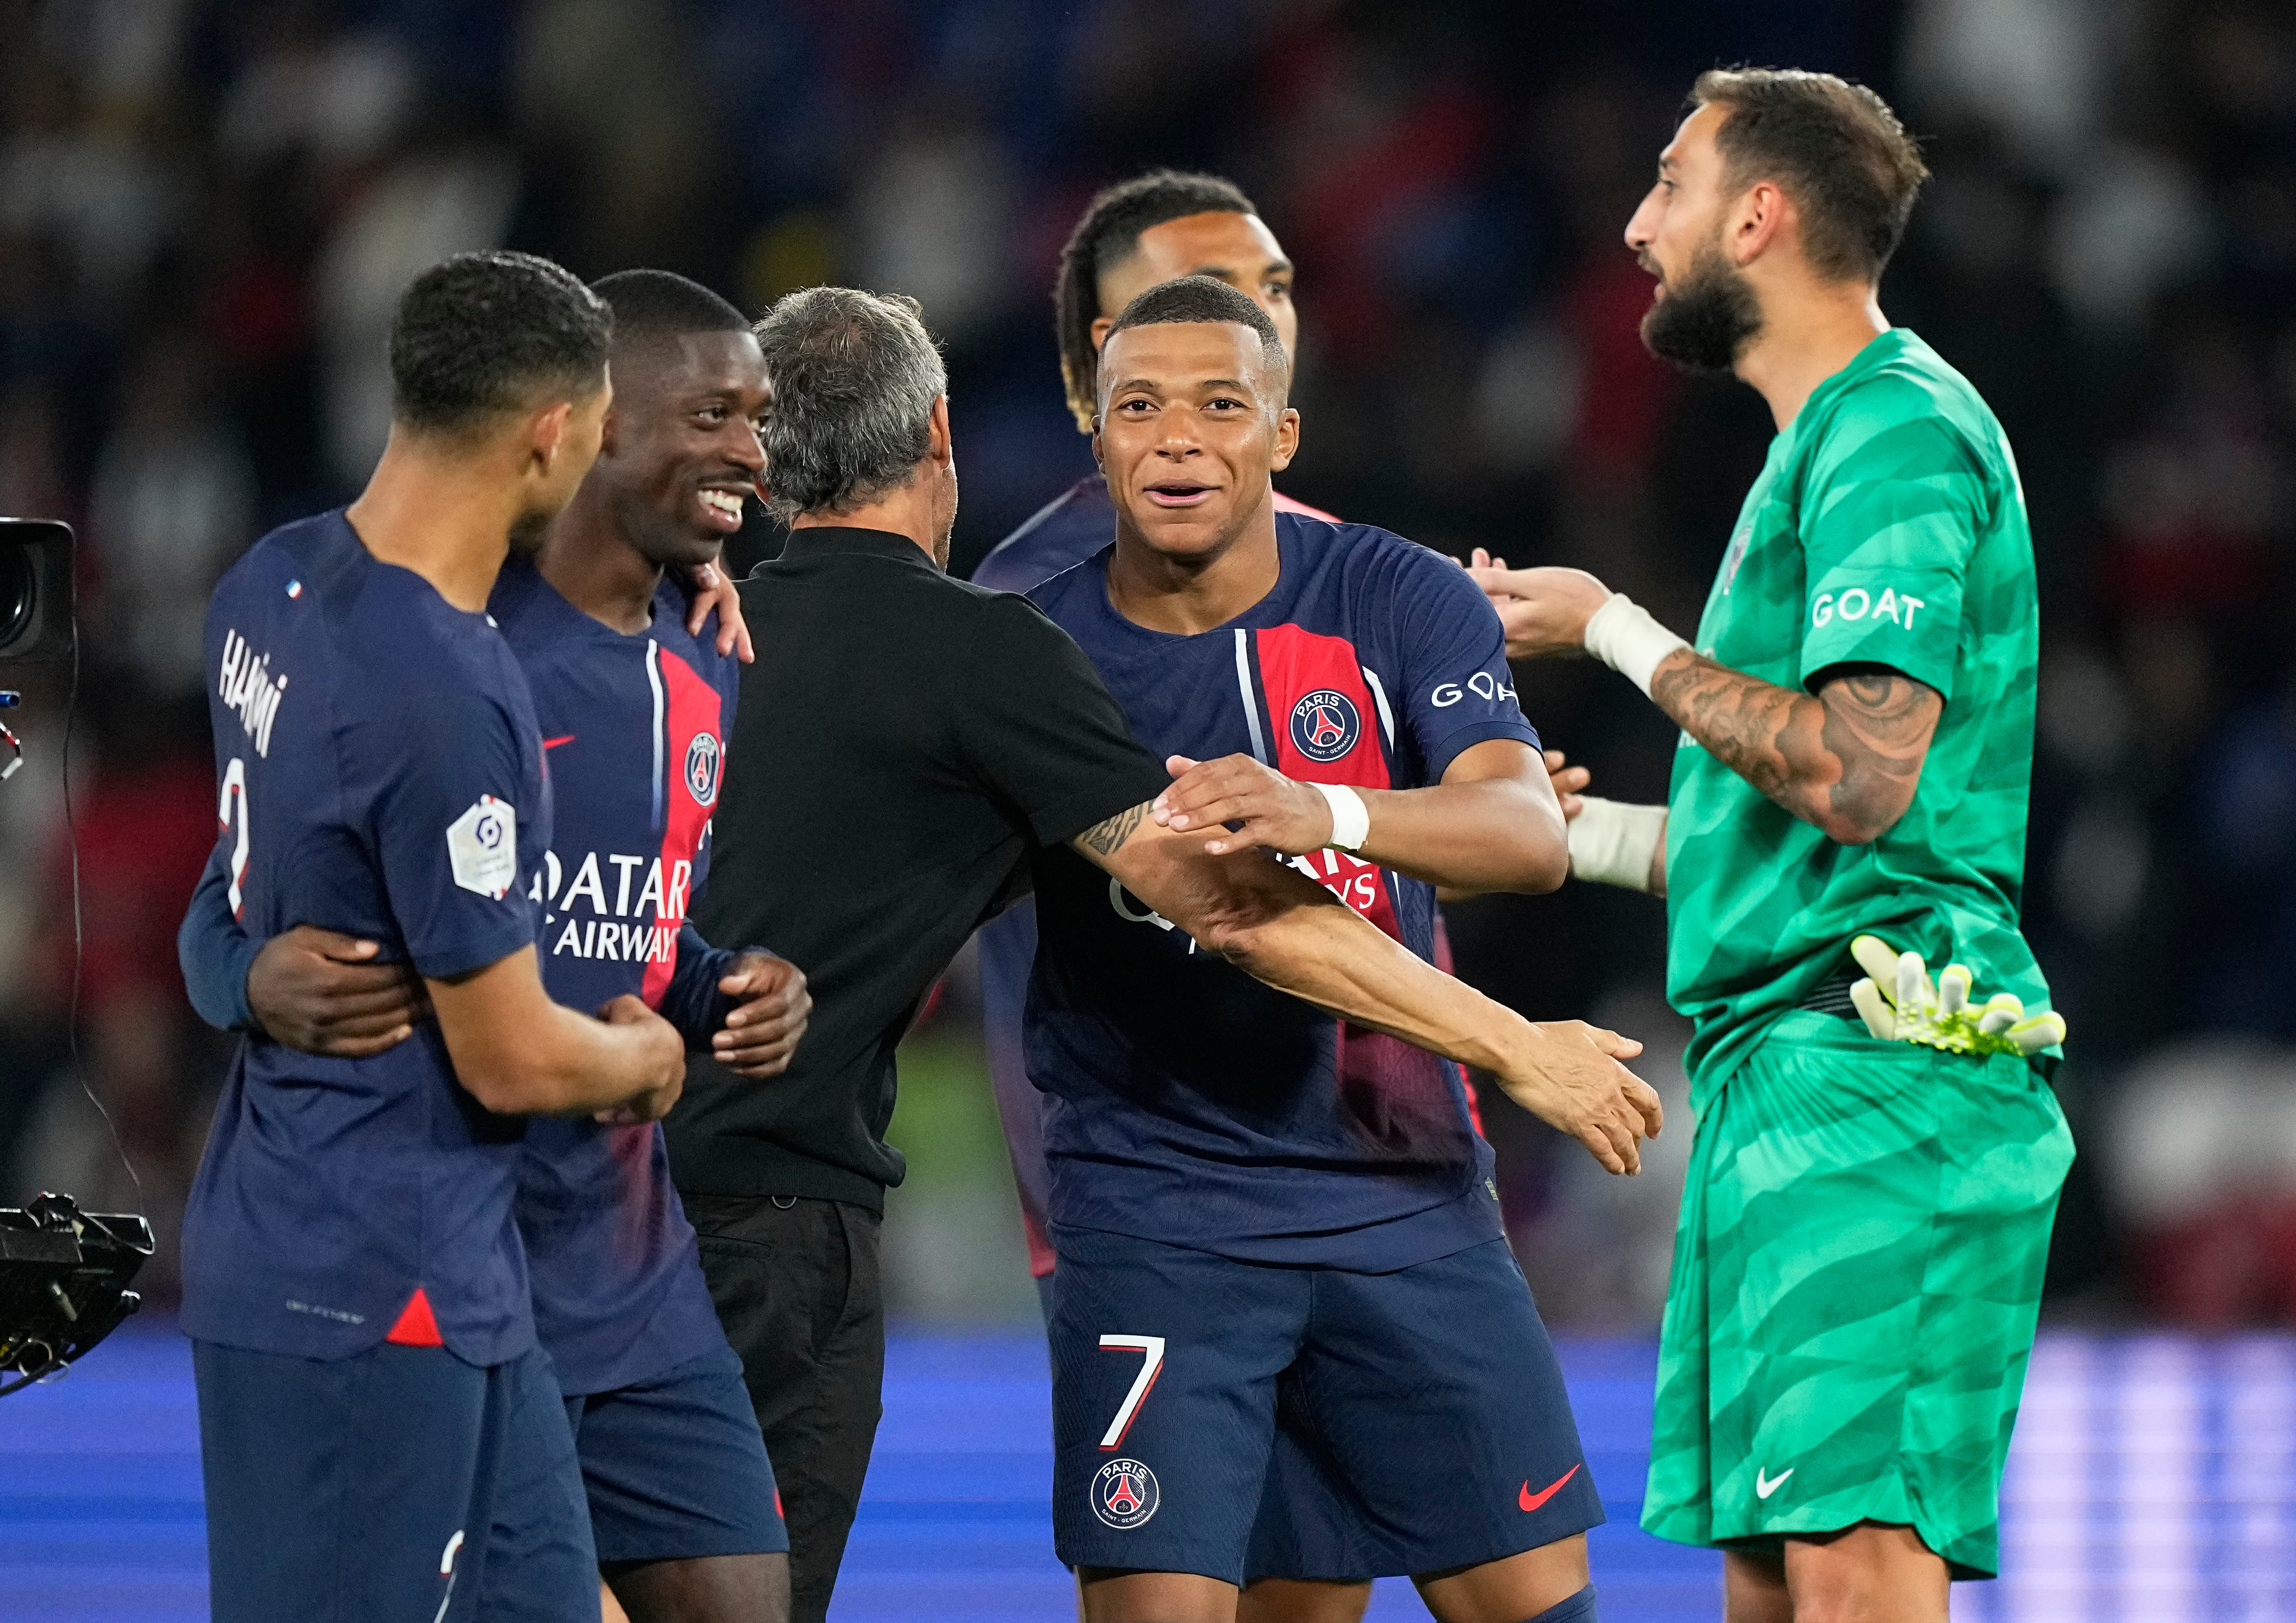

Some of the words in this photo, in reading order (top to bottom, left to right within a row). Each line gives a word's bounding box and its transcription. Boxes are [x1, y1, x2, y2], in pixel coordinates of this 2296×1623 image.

[1812, 587, 1925, 630] GOAT
[1296, 694, 1340, 717] PARIS
[1431, 671, 1520, 707] GOA
[552, 918, 681, 964] AIRWAY
[1099, 1334, 1165, 1451] 7
[1102, 1462, 1147, 1481] PARIS
